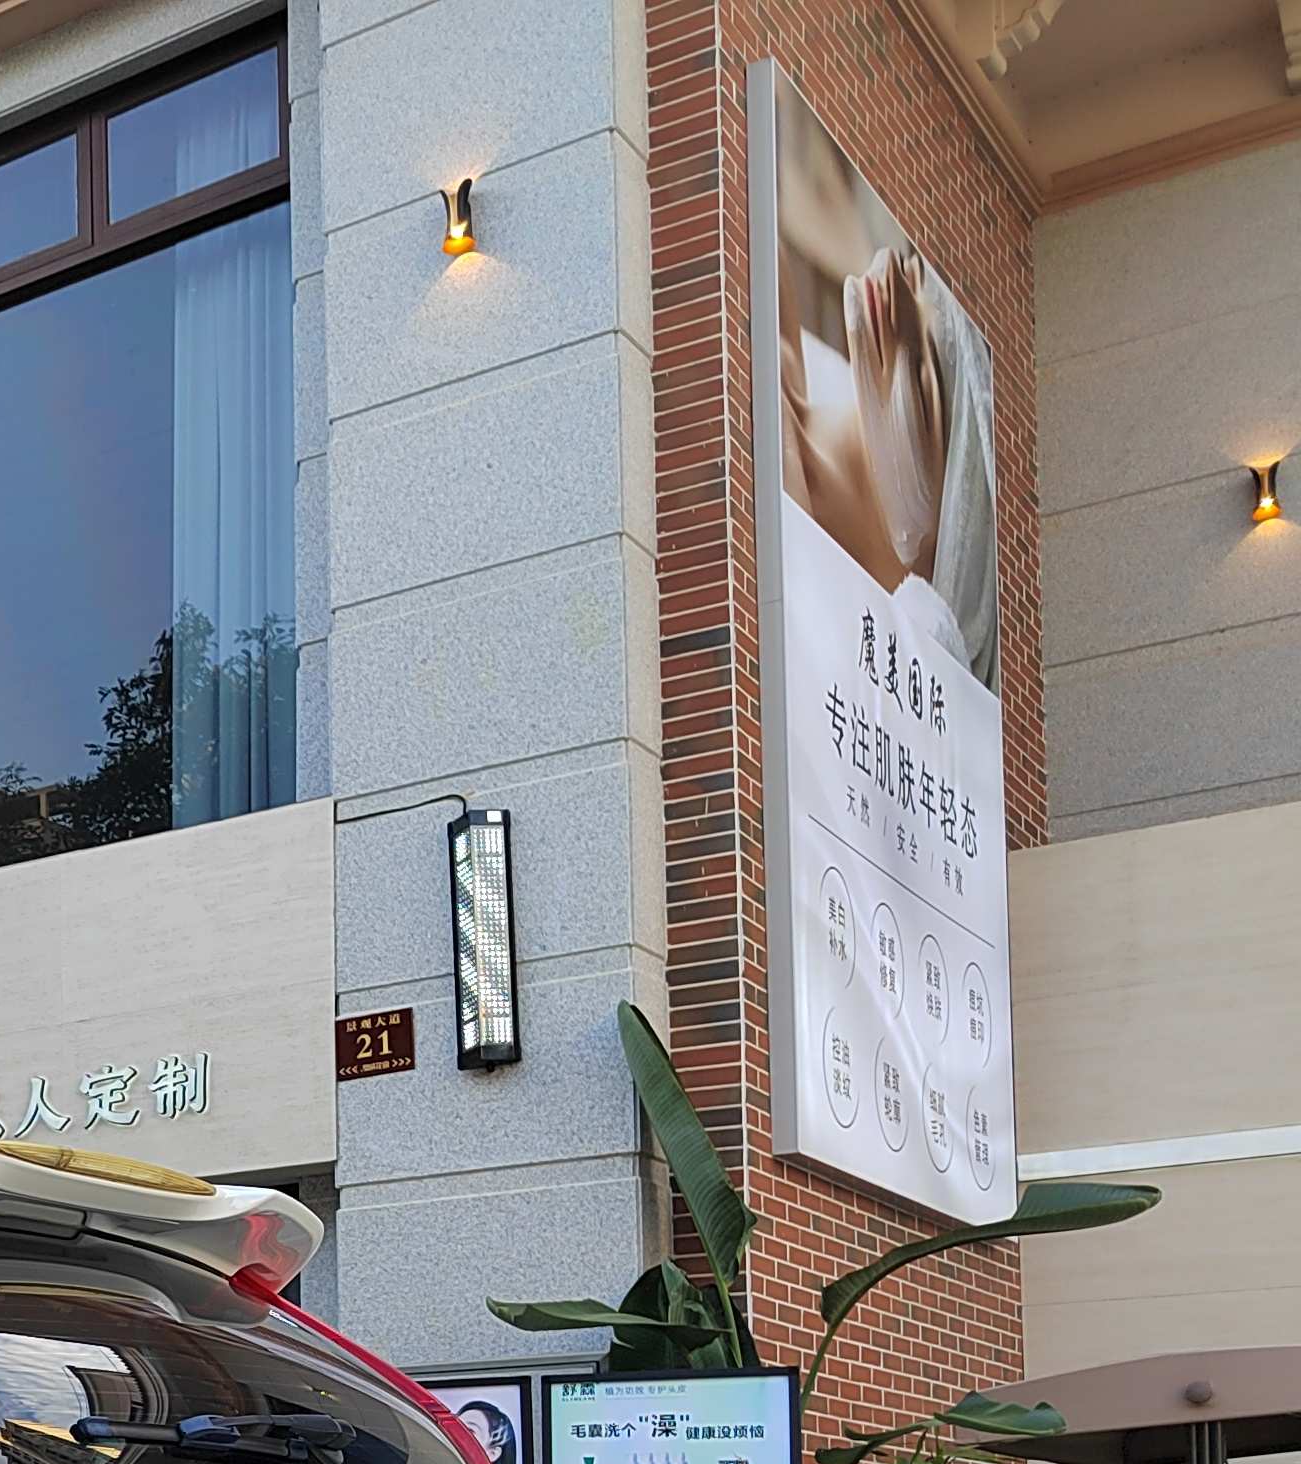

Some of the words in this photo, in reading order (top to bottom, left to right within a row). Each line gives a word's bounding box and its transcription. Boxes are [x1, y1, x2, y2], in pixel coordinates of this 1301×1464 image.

[825, 682, 977, 858] 专注肌肤年轻态
[356, 1030, 393, 1059] 21
